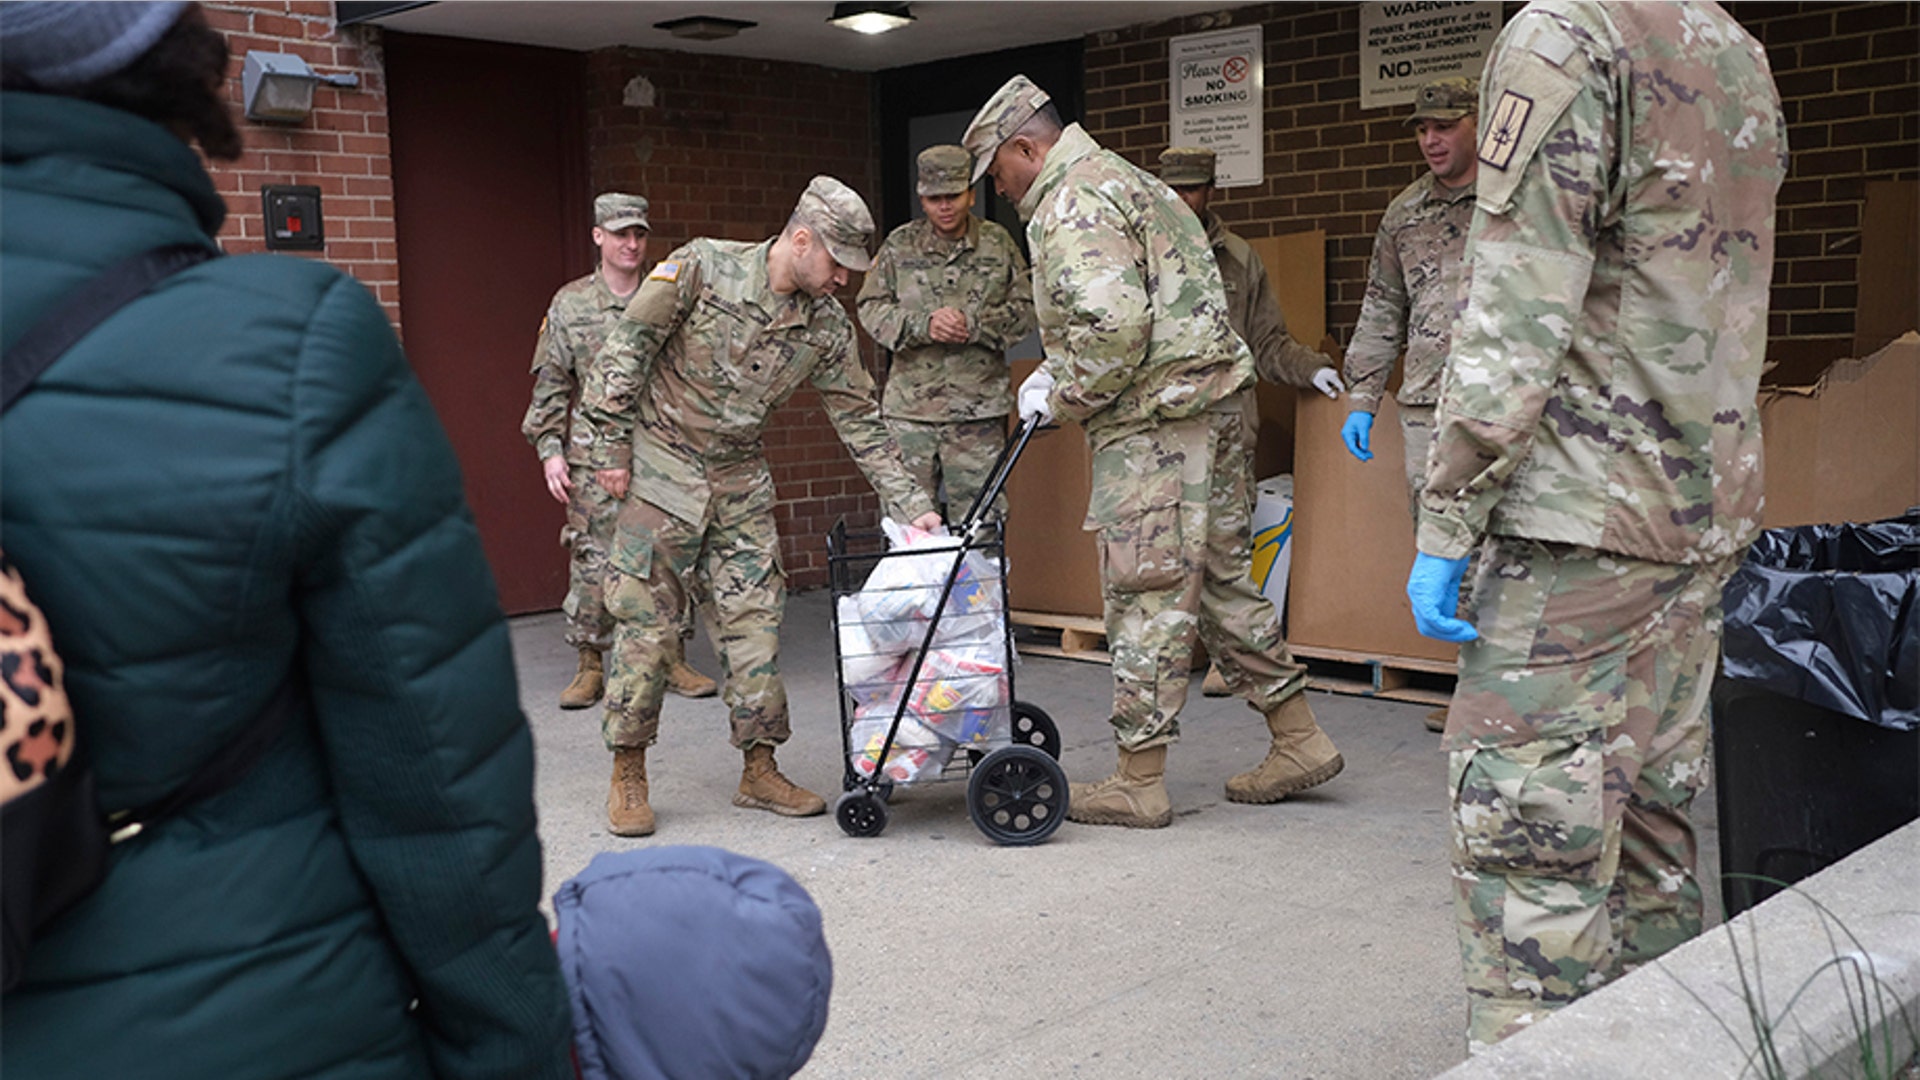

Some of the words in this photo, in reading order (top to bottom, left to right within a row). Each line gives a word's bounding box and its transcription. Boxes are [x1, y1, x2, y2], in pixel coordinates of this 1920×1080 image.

[1382, 1, 1475, 17] WARNI
[1369, 23, 1404, 36] PRIVATE
[1408, 15, 1457, 30] PROPERTY
[1461, 13, 1472, 22] of
[1475, 11, 1491, 20] the
[1367, 37, 1389, 47] NEW
[1391, 28, 1438, 43] ROCHELLE
[1442, 21, 1492, 36] MUNICIPAL
[1381, 42, 1422, 56] HOUSING
[1425, 34, 1478, 50] AUTHORITY
[1183, 63, 1222, 79] Please
[1379, 61, 1412, 79] NO
[1413, 51, 1482, 65] TRESPASSING
[1414, 62, 1463, 76] LOITERING
[1206, 79, 1227, 91] NO
[1185, 90, 1248, 106] SMOKING
